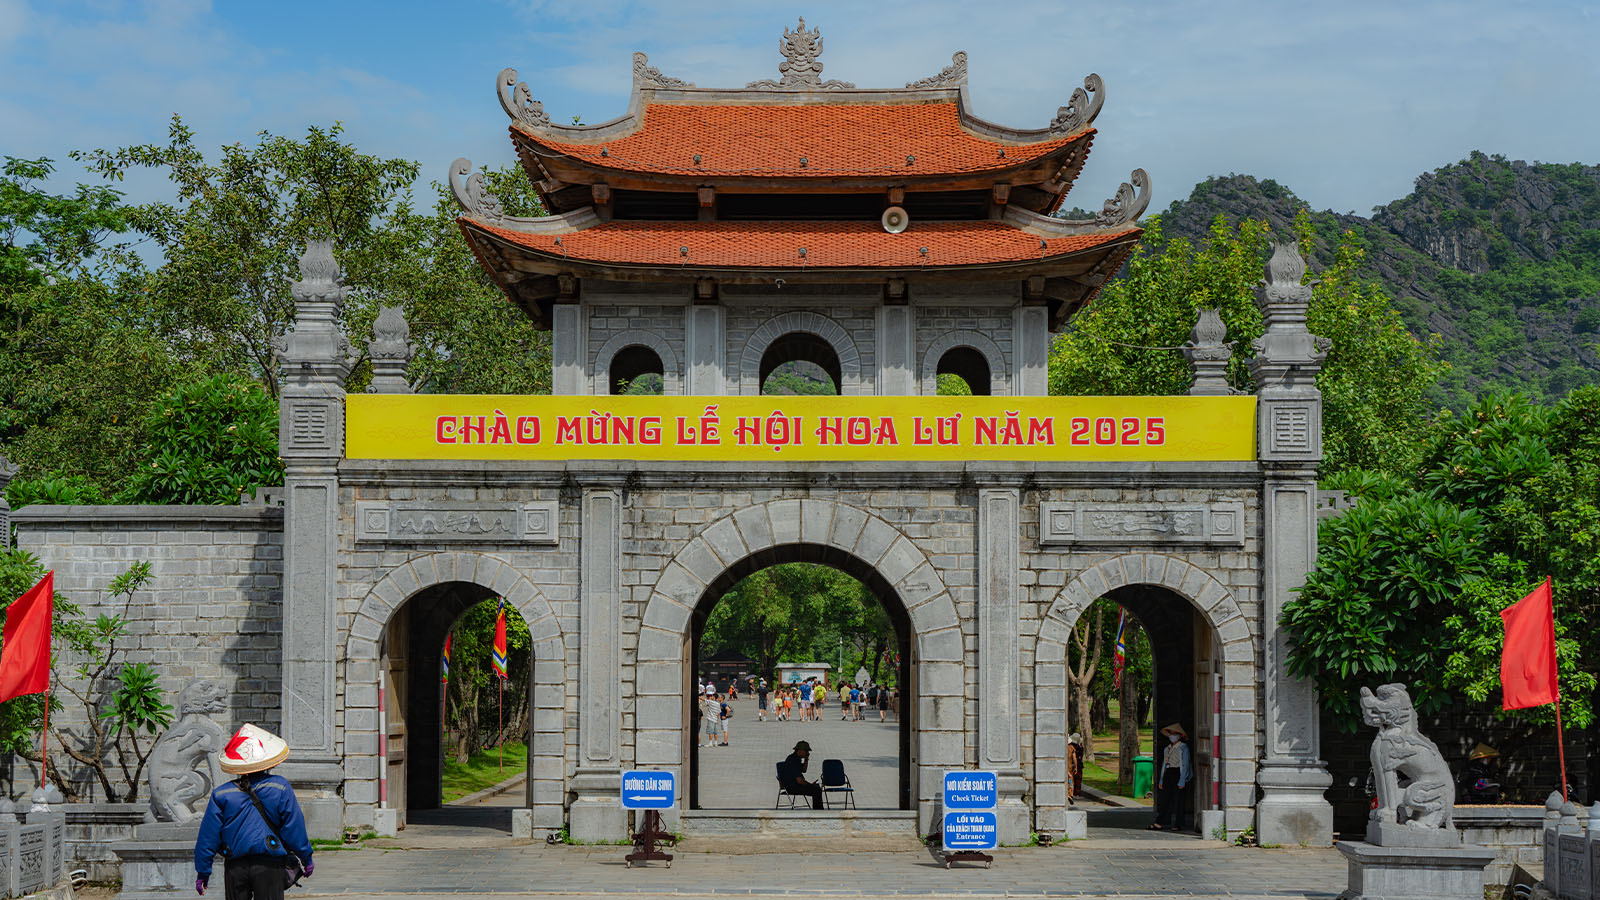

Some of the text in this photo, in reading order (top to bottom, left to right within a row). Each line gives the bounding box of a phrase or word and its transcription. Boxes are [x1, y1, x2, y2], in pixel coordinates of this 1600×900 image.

[436, 404, 1165, 452] CHÀO MỪNG LỄ HỘI HOA LƯ NĂM 2025
[625, 777, 672, 790] ĐƯỜNG DÂN SINH
[958, 777, 971, 791] KIỂM
[972, 779, 986, 791] SOÁT
[987, 779, 994, 791] VÉ
[957, 815, 984, 823] LỐI VÀO
